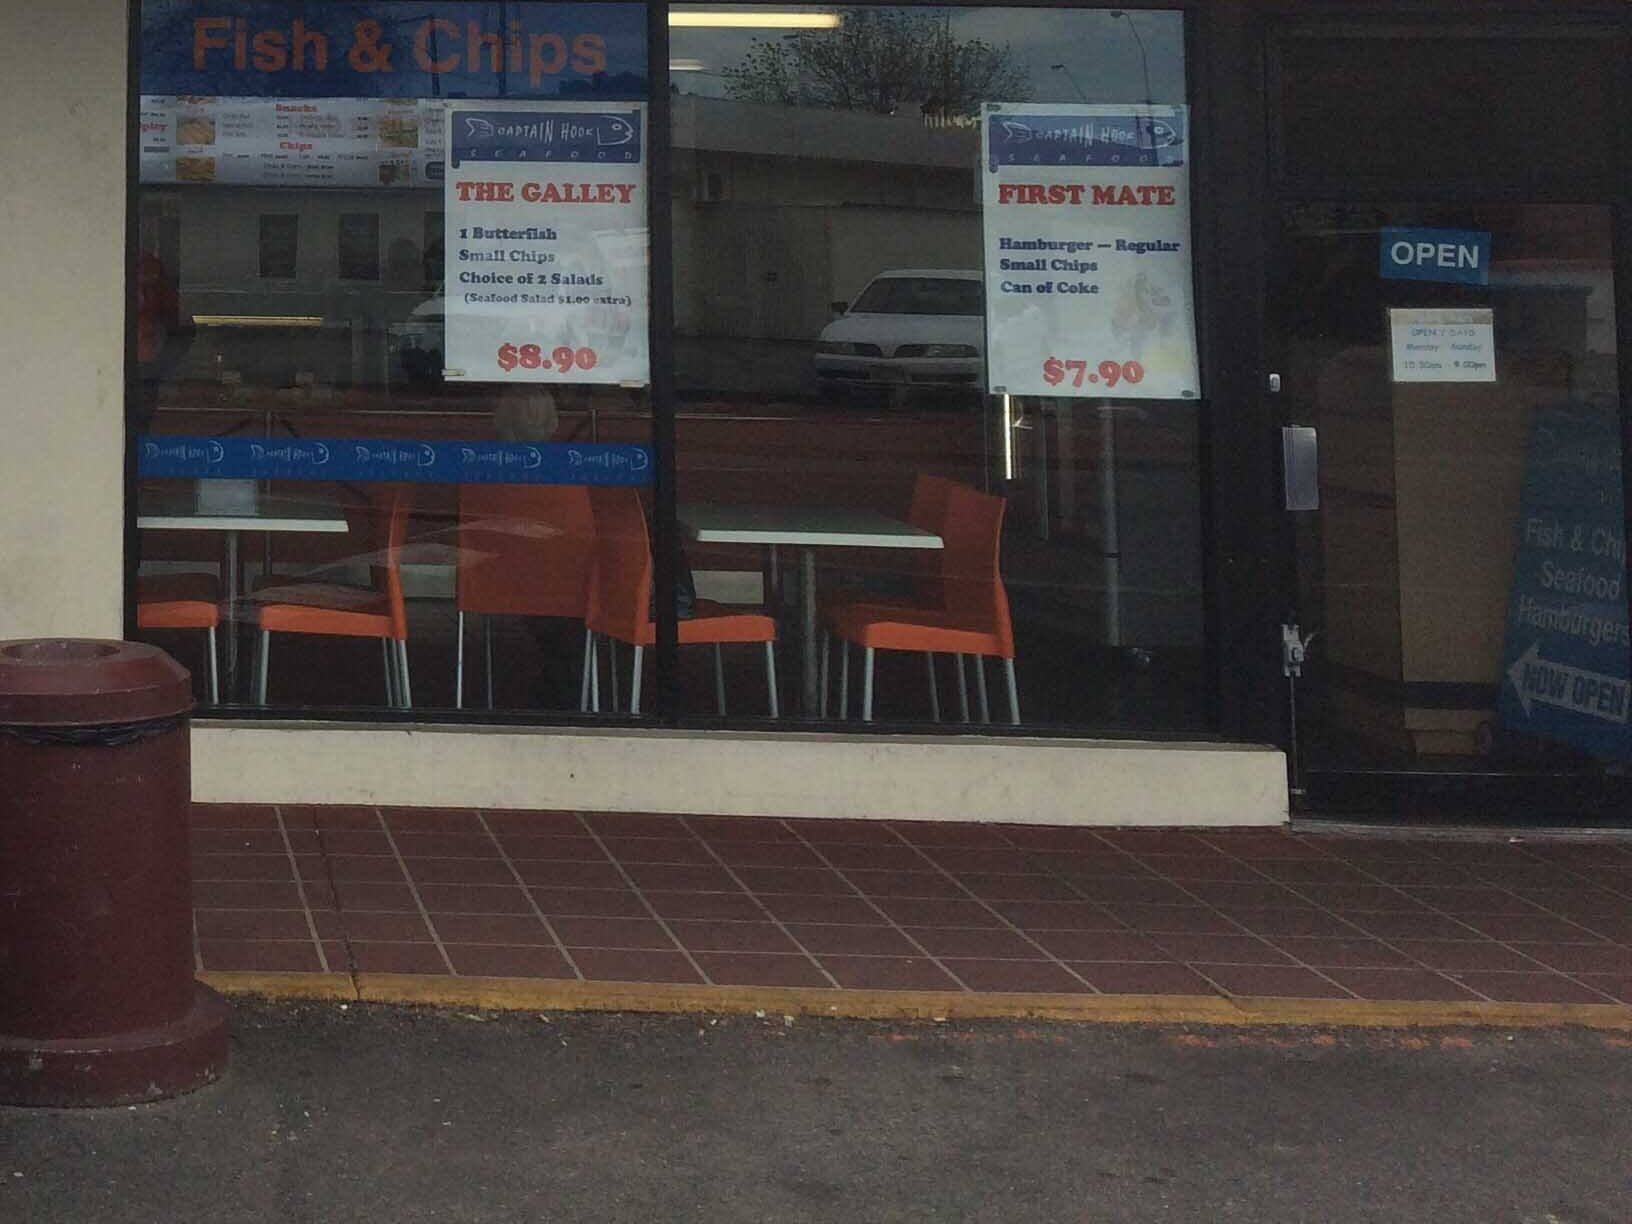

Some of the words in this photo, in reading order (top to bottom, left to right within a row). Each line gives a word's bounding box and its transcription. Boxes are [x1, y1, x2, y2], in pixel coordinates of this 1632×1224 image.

[193, 17, 327, 72] Fish
[349, 19, 394, 72] &
[413, 19, 606, 89] Chips
[498, 119, 553, 141] CAPTAIN
[561, 123, 593, 140] HOOK
[456, 182, 514, 201] THE
[521, 183, 636, 203] GALLEY
[998, 184, 1085, 205] FIRST
[1092, 185, 1176, 205] MATE
[459, 229, 467, 239] 1
[472, 228, 557, 240] Butterfish
[459, 249, 505, 262] Small
[509, 250, 555, 264] Chips
[1000, 238, 1093, 252] Hamburger
[1115, 239, 1180, 254] Regular
[1391, 241, 1478, 268] OPEN
[1000, 259, 1046, 271] Small
[1051, 260, 1098, 273] Chips
[459, 272, 513, 285] Choice
[517, 273, 534, 285] of
[537, 275, 547, 285] 2
[551, 273, 603, 286] Salads
[1001, 281, 1032, 293] Can
[1036, 281, 1053, 293] of
[1057, 282, 1099, 294] Coke
[464, 292, 518, 303] (Seafood
[521, 294, 555, 304] Salad
[593, 295, 632, 306] extra)
[497, 343, 597, 373] $8.90
[1043, 357, 1144, 388] $7.90
[1525, 518, 1565, 550] Fish
[1571, 525, 1585, 553] &
[1542, 560, 1620, 600] Seafood
[1519, 594, 1630, 648] Hamburgers
[1521, 662, 1562, 701] NOW
[1567, 674, 1626, 717] OPEN
